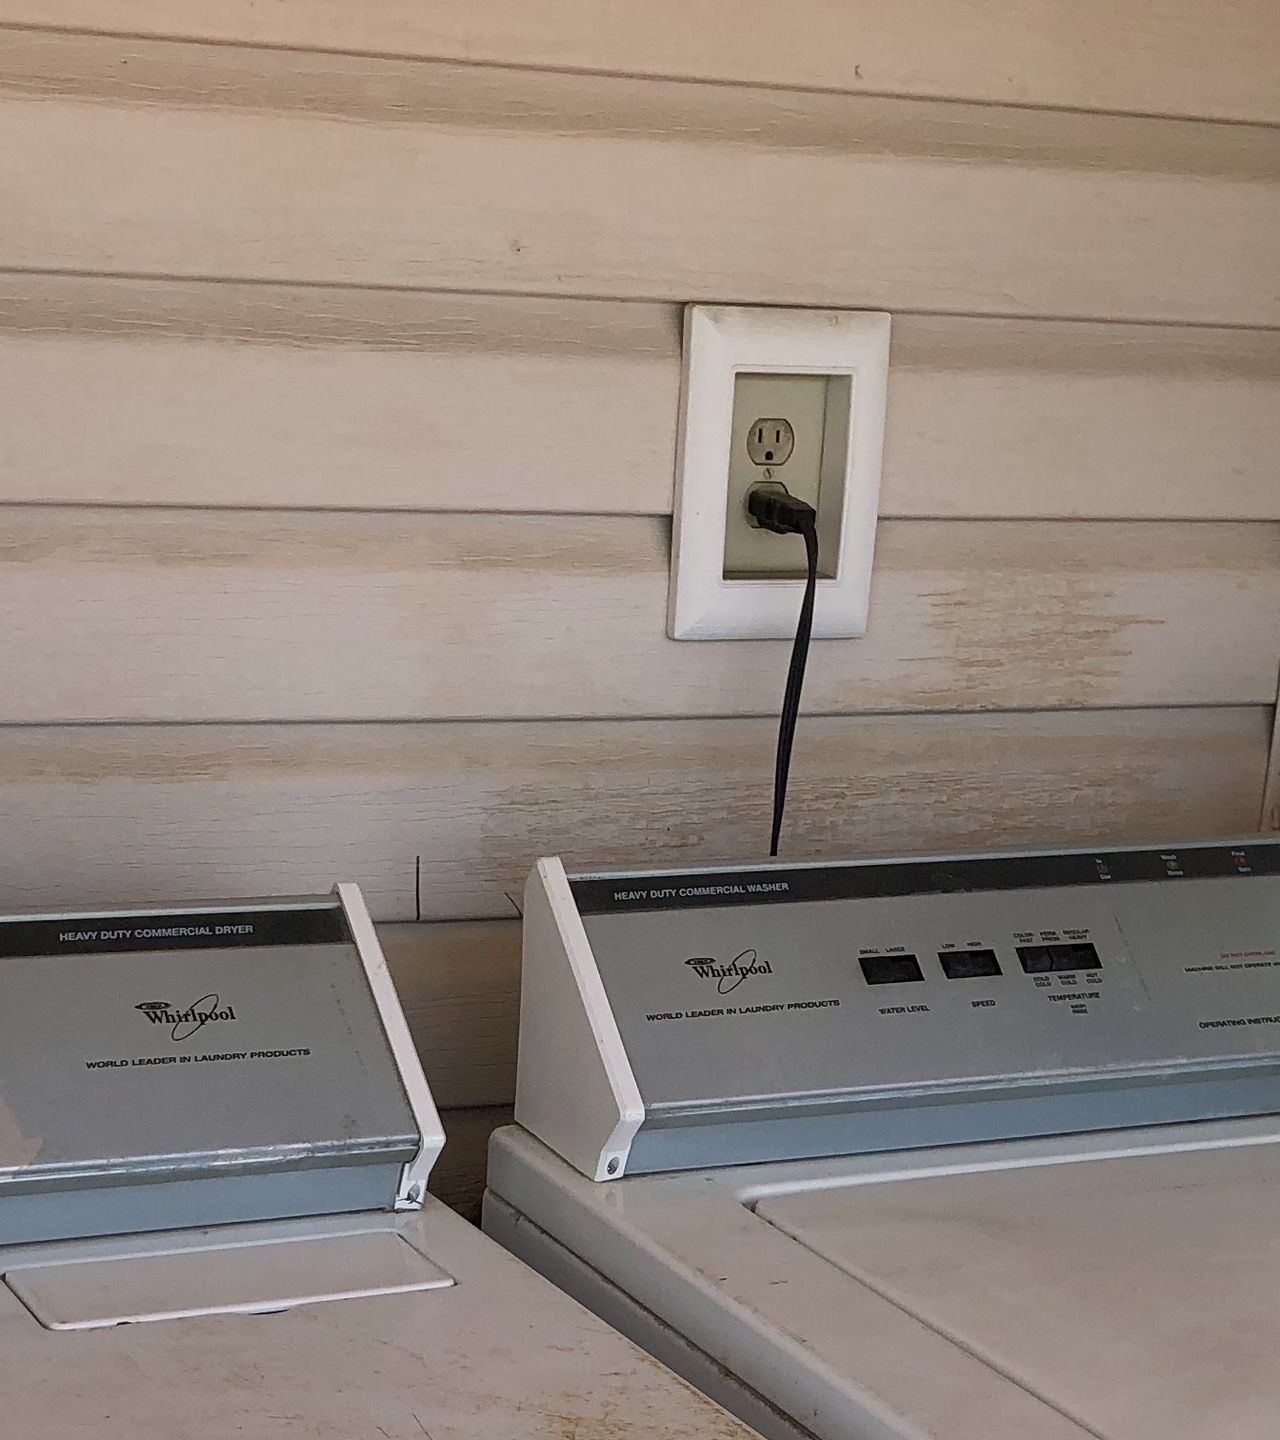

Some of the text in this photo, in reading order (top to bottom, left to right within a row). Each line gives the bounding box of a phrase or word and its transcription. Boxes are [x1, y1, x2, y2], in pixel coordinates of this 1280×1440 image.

[614, 882, 789, 901] HEAVY DUTY COMMERCIAL WASHER
[59, 924, 254, 942] HEAVY DUTY COMMERCIAL DRYER
[692, 960, 773, 980] Whirlpool
[971, 1000, 996, 1008] SPEED
[1048, 992, 1100, 1001] TEMPERATURE
[143, 1006, 237, 1026] Whirlpool
[646, 999, 841, 1022] WORLD LEADER IN LAUNDRY PRODUCTS
[879, 1005, 930, 1015] WATER LEVEL
[1198, 1019, 1246, 1029] OPERATING
[86, 1048, 311, 1070] WORLD LEADER IN LAUNDRY PRODUCTS
